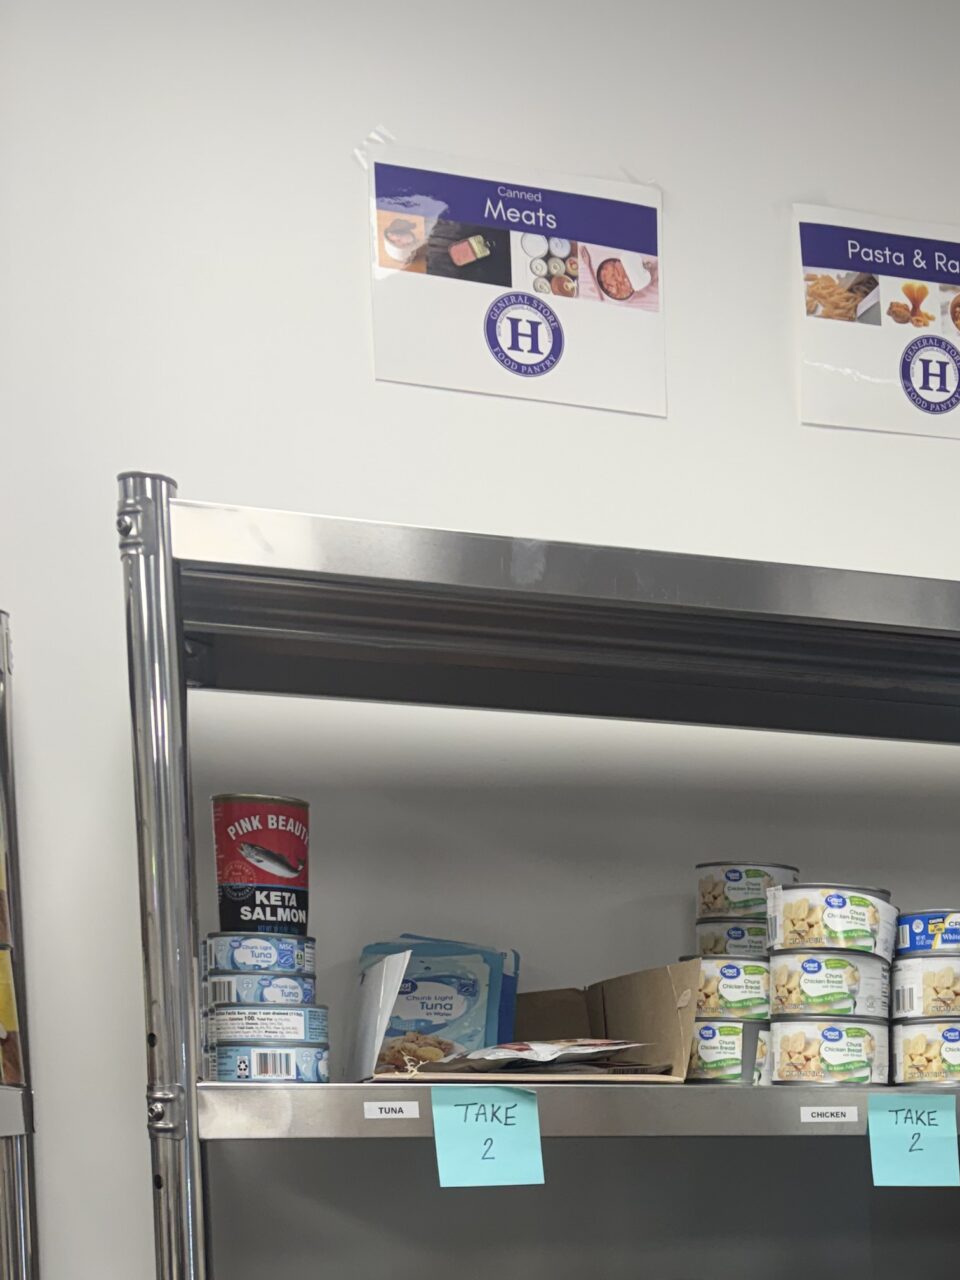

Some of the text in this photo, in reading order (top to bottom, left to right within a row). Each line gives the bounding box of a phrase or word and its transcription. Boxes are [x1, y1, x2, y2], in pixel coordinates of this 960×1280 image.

[497, 186, 542, 202] Canned
[484, 198, 557, 229] Meats
[848, 240, 905, 266] Pasta
[913, 250, 927, 268] &
[490, 295, 558, 329] GENERAL STORE
[507, 317, 544, 355] H
[493, 347, 557, 374] FOOD PANTRY
[919, 358, 950, 393] H
[226, 815, 262, 840] PINK
[255, 891, 297, 906] KETA
[240, 906, 306, 924] SALMON
[280, 990, 299, 998] Tuna
[420, 1001, 453, 1011] Tuna
[378, 1106, 404, 1115] TUNA
[454, 1103, 517, 1127] TAKE
[888, 1108, 938, 1127] TAKE
[481, 1138, 495, 1161] 2
[908, 1132, 924, 1152] 2
